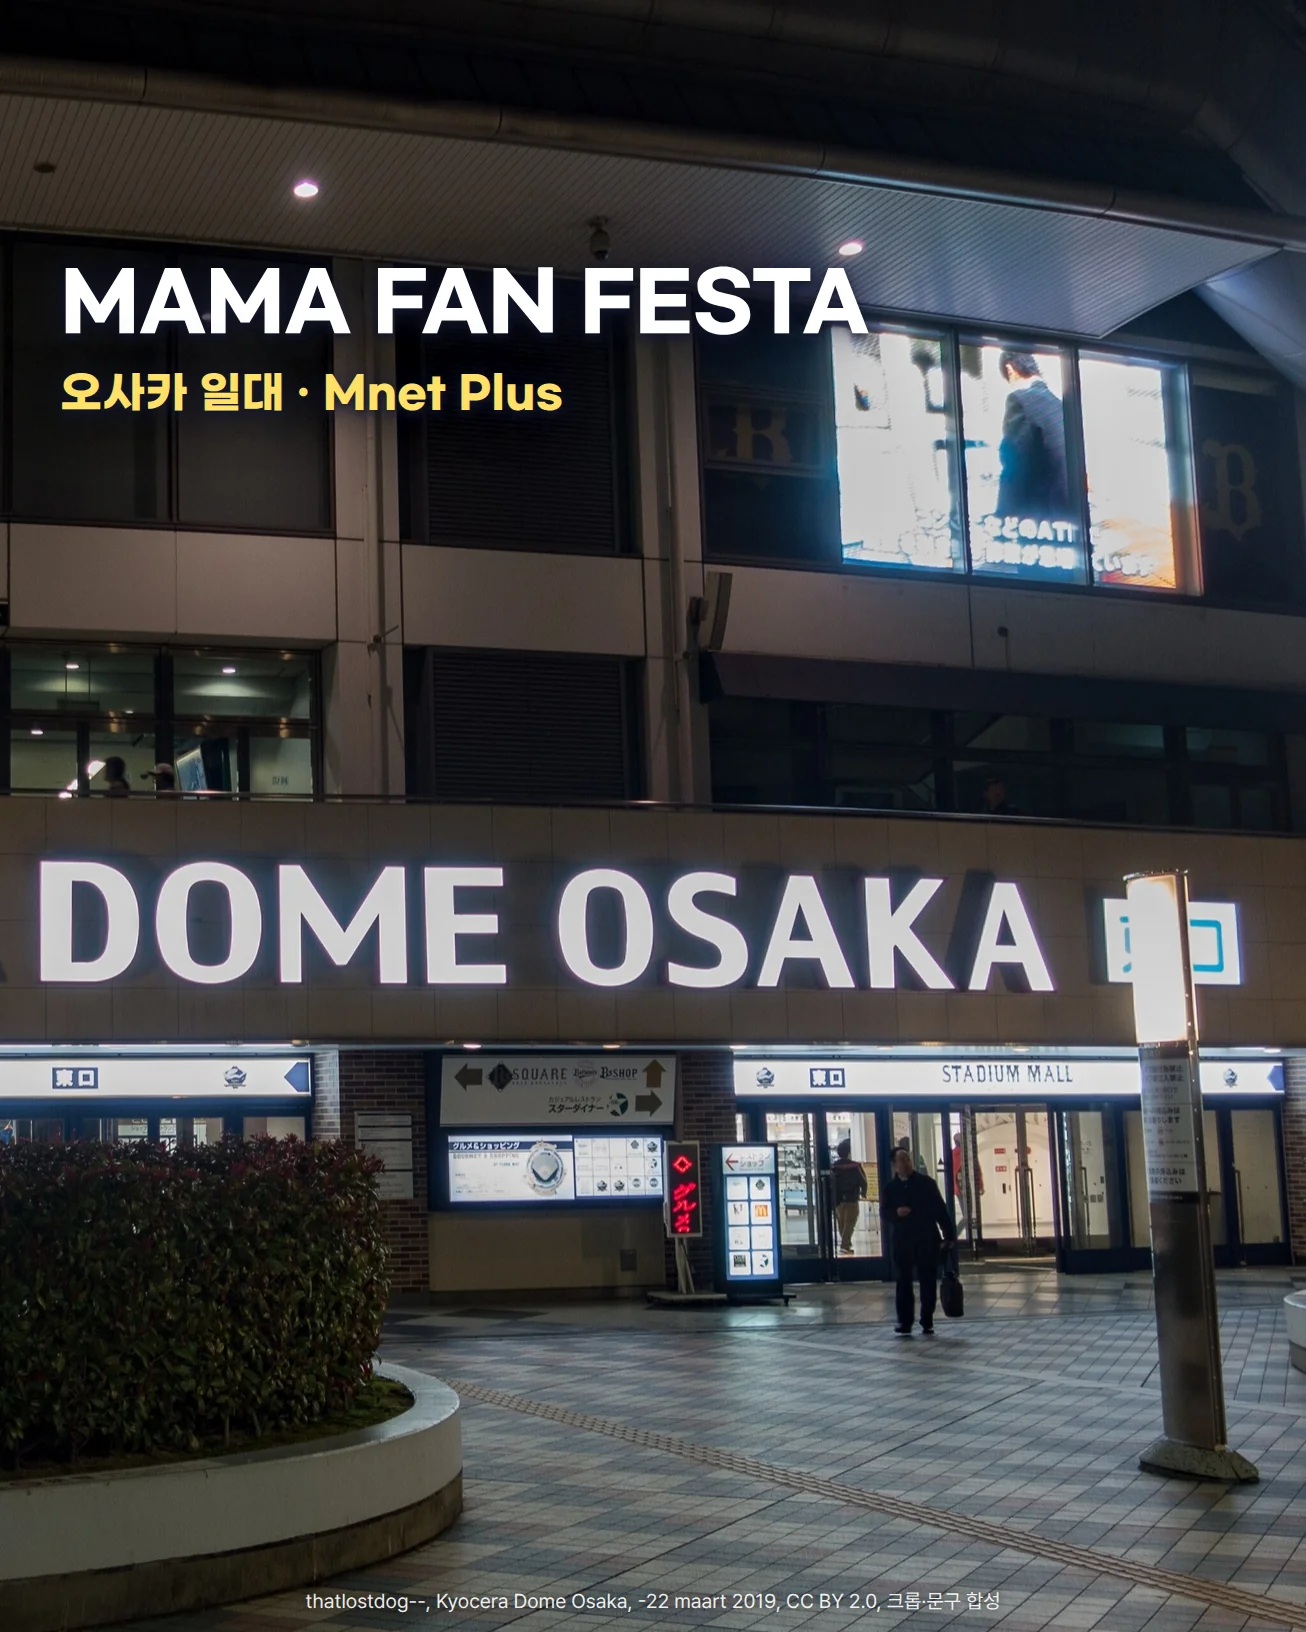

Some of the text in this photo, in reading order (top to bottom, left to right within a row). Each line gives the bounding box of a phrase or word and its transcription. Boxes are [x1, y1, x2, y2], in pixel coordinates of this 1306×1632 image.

[39, 861, 1054, 991] DOME OSAKA
[55, 1069, 95, 1087] 東口
[512, 1067, 568, 1081] SQUARE
[942, 1064, 1073, 1083] STADIUM MALL
[548, 1103, 605, 1114] スターダイナー
[452, 1141, 520, 1151] グルメ&ショッピング
[739, 1159, 765, 1168] ショップ
